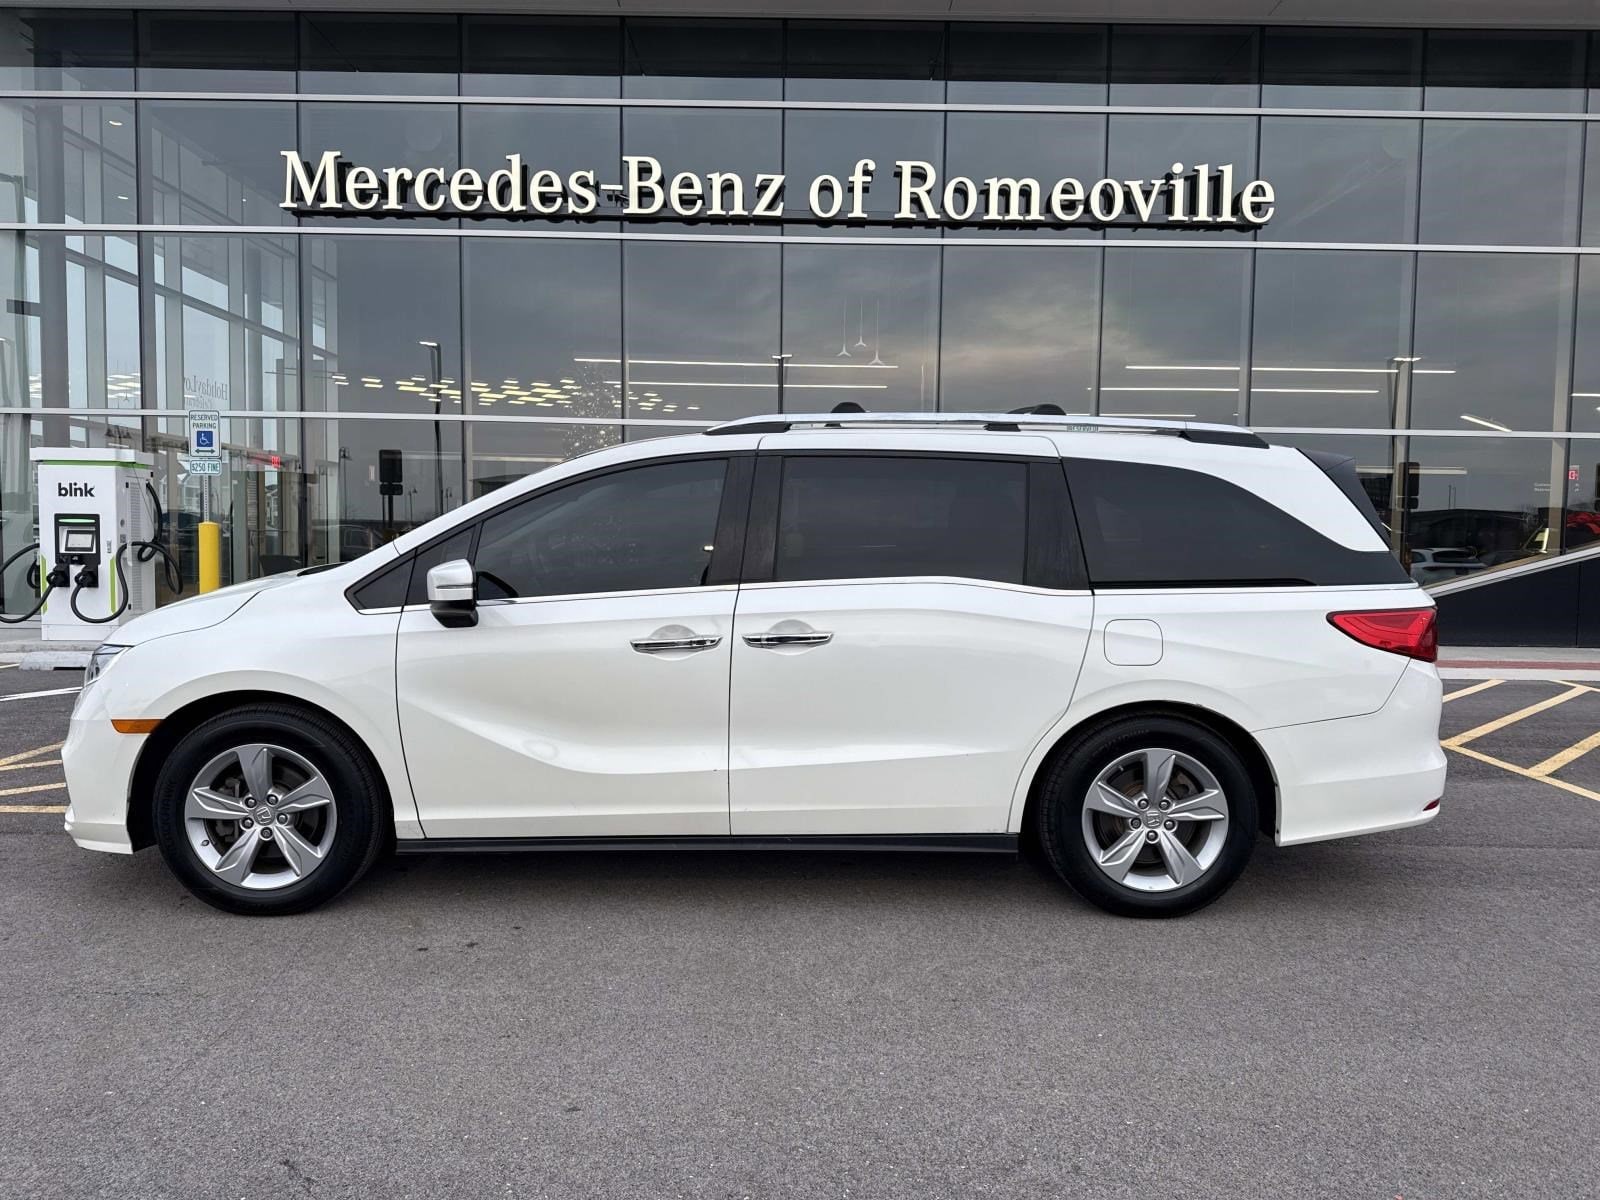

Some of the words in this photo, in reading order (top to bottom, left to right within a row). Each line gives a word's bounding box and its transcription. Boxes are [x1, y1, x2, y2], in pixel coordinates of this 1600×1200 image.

[279, 150, 786, 218] Mercedes-Benz
[809, 158, 876, 219] of
[894, 160, 1276, 224] Romeoville
[191, 462, 206, 472] $250
[207, 462, 219, 472] FINE
[57, 482, 96, 498] blink
